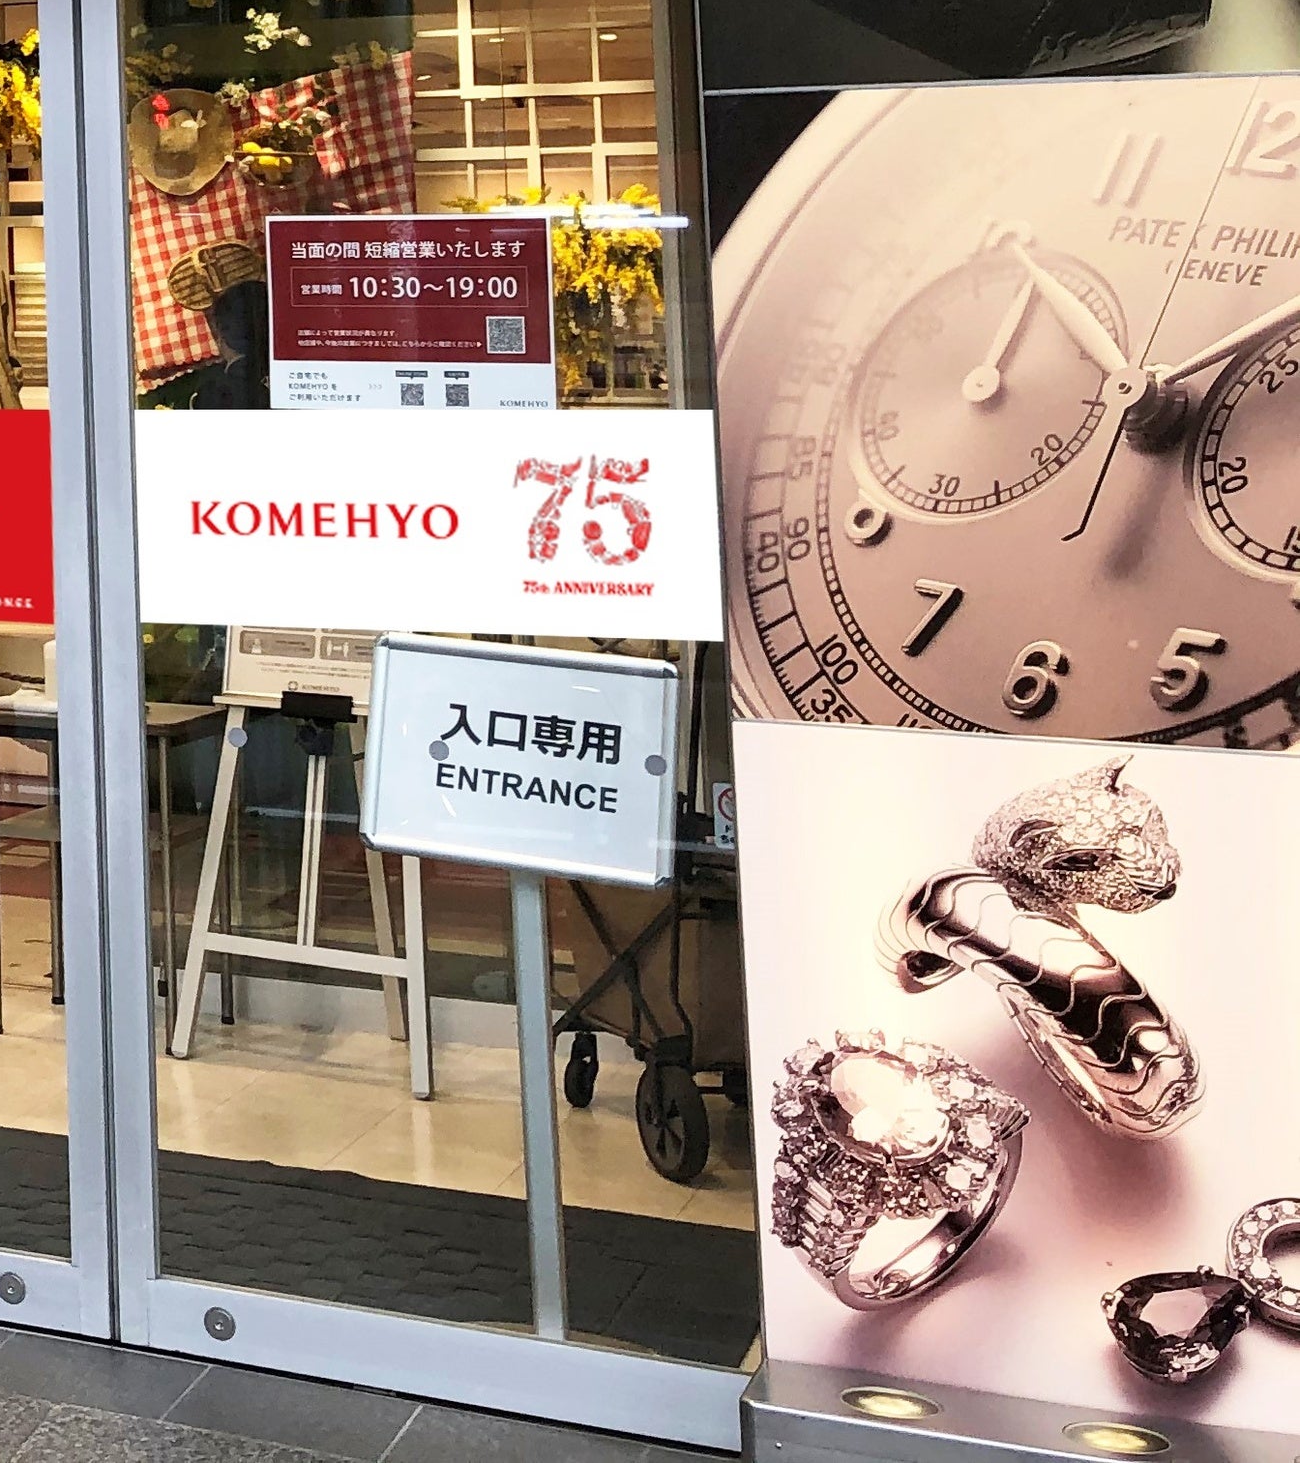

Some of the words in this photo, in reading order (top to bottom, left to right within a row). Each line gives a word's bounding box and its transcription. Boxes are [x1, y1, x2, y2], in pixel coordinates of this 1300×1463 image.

[291, 241, 361, 259] 当面の間
[364, 240, 526, 259] 短縮営業いたします
[300, 284, 343, 295] 営業時間
[1258, 353, 1299, 394] 25
[500, 400, 548, 408] KOMEHYO
[1031, 433, 1064, 466] 20
[928, 473, 961, 498] 30
[1218, 456, 1248, 495] 20
[190, 500, 460, 539] KOMEHYO
[513, 453, 653, 568] 75
[785, 517, 812, 561] 90
[553, 580, 654, 597] ANNIVERSARY
[901, 578, 965, 658] 7
[815, 633, 860, 686] 100
[1001, 640, 1070, 720] 6
[1149, 627, 1227, 713] 5
[440, 703, 623, 766] 入口専用
[435, 763, 619, 815] ENTRANCE
